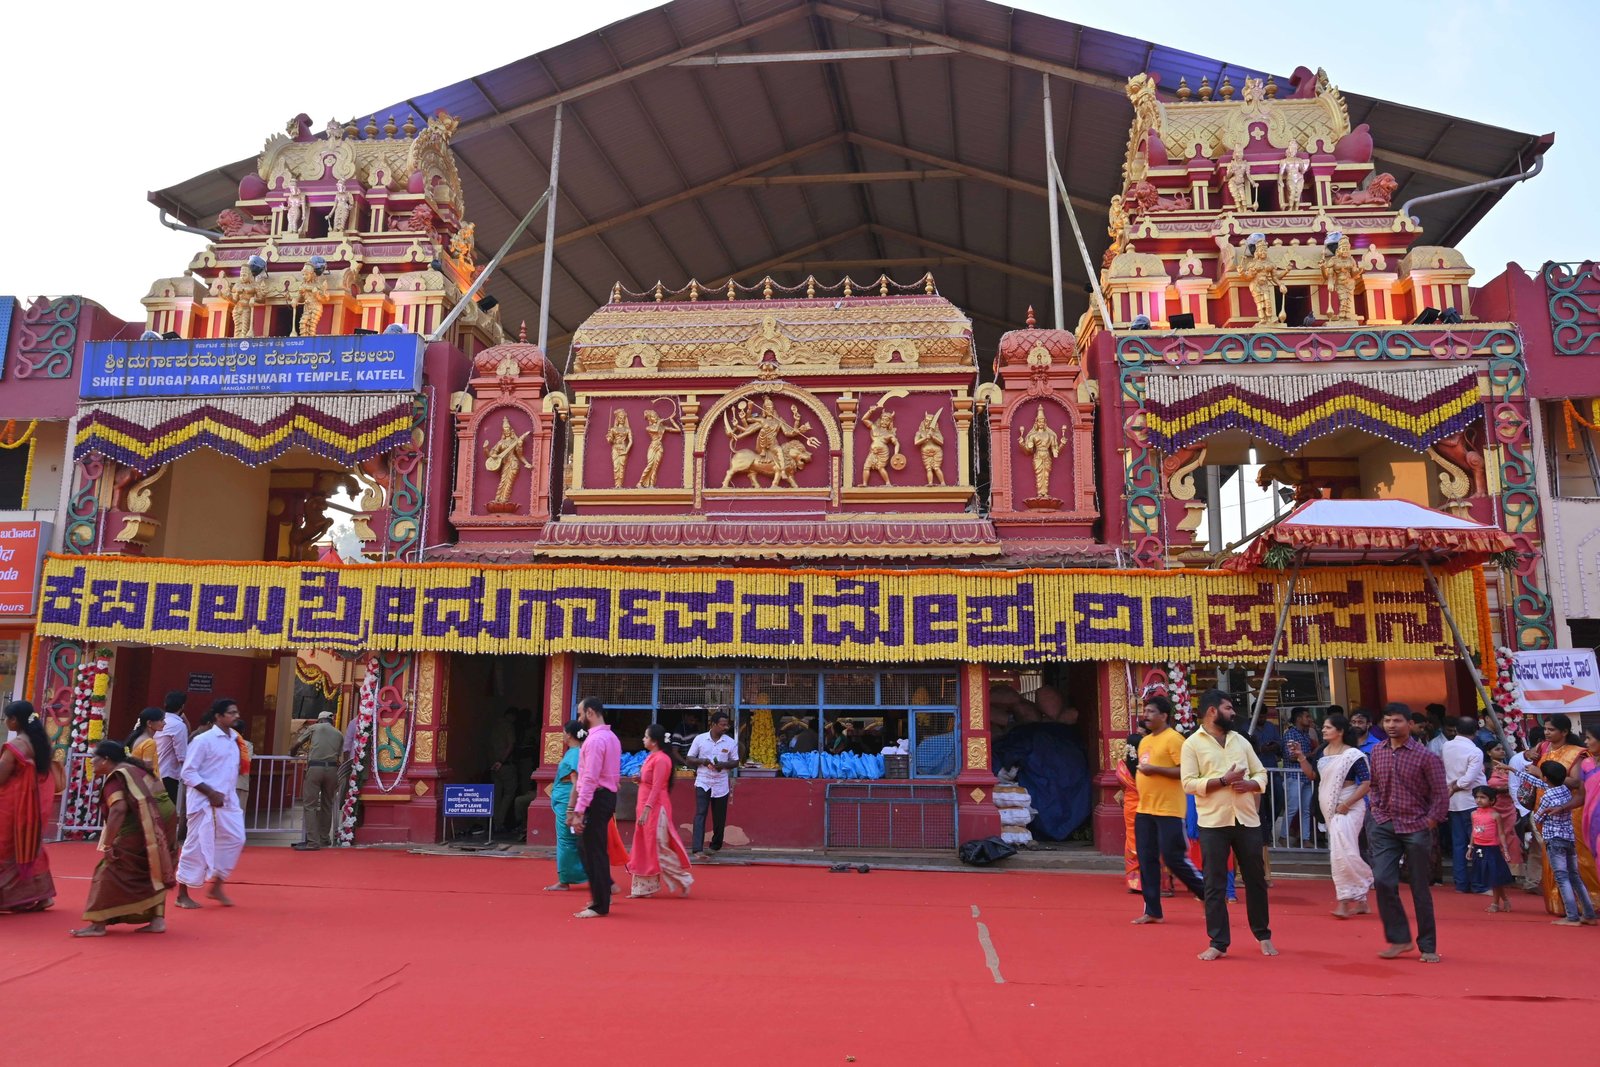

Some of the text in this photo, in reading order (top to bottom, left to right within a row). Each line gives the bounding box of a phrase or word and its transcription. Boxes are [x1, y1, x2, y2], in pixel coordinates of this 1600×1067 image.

[104, 353, 125, 374] ಶ್ರೀ
[341, 347, 395, 364] ಕಟೀಲು
[92, 369, 406, 388] SHREE DURGAPARAMESHWARI TEMPLE, KATEEL
